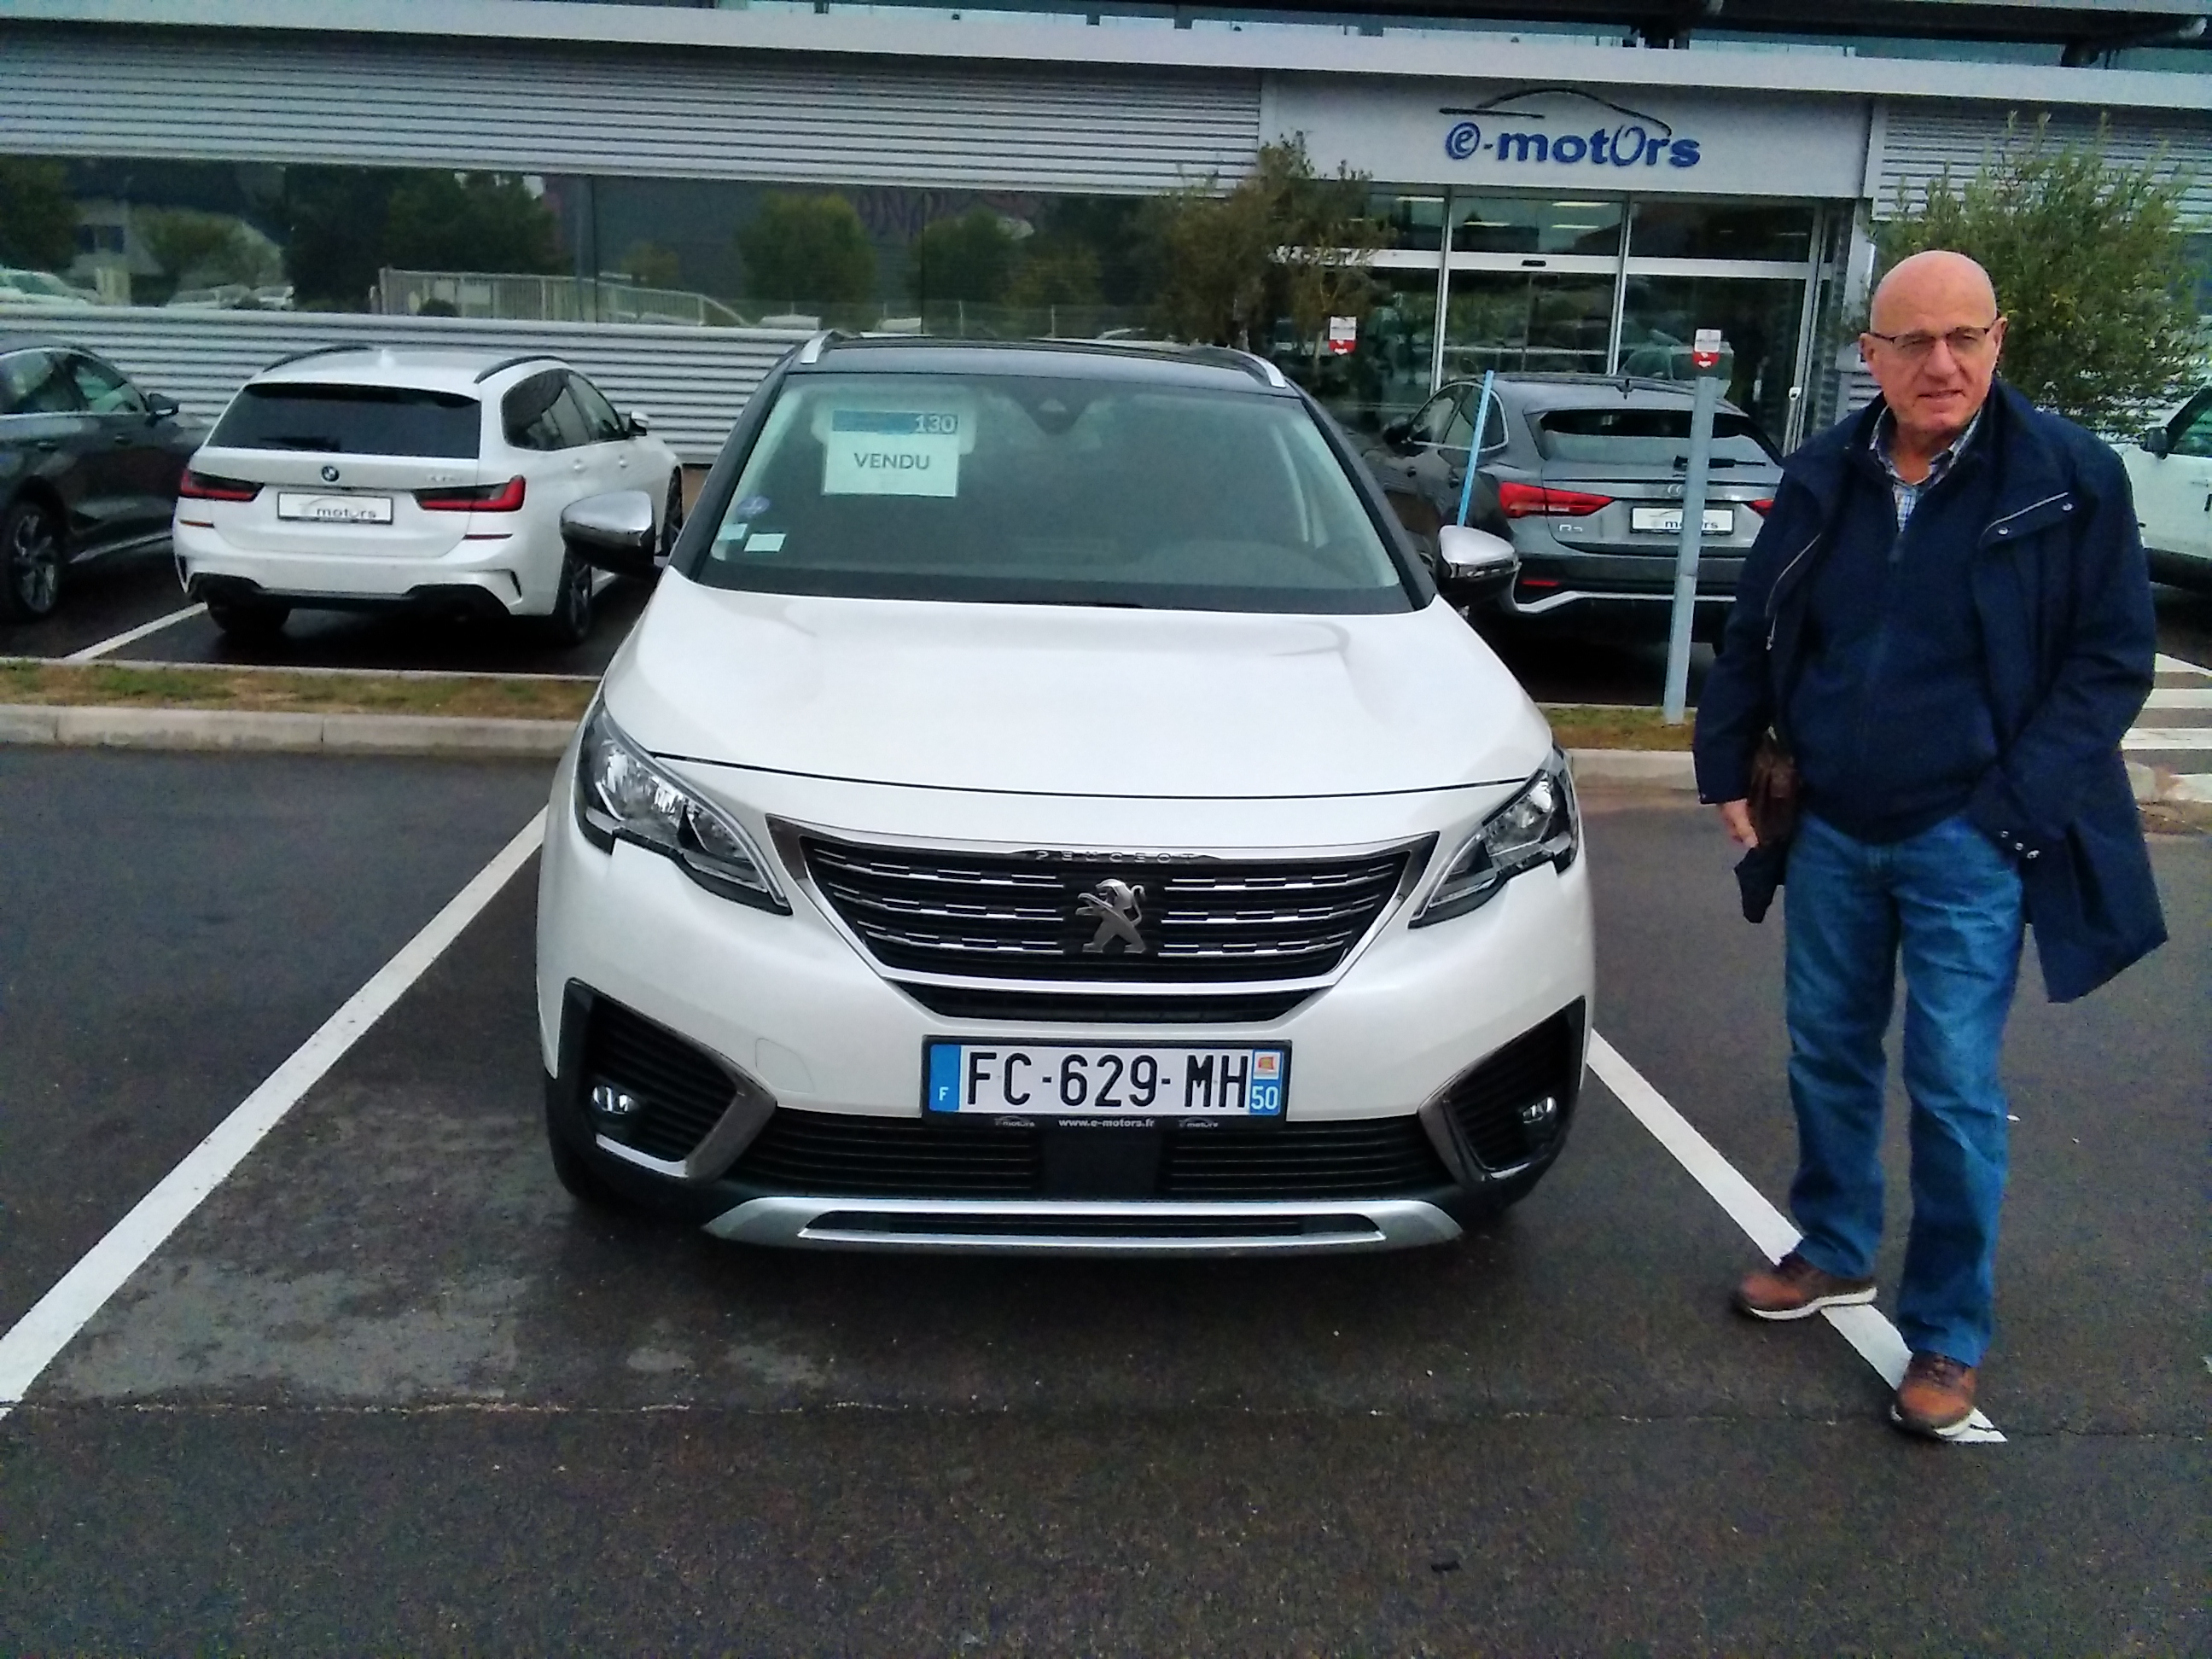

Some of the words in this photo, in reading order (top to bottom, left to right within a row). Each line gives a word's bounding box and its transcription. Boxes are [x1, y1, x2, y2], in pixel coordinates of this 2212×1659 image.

[914, 414, 958, 434] 130
[853, 452, 930, 470] VENDU
[938, 1086, 949, 1102] F
[1252, 1086, 1279, 1110] 50
[1058, 1118, 1155, 1128] www.e-motors.fr
